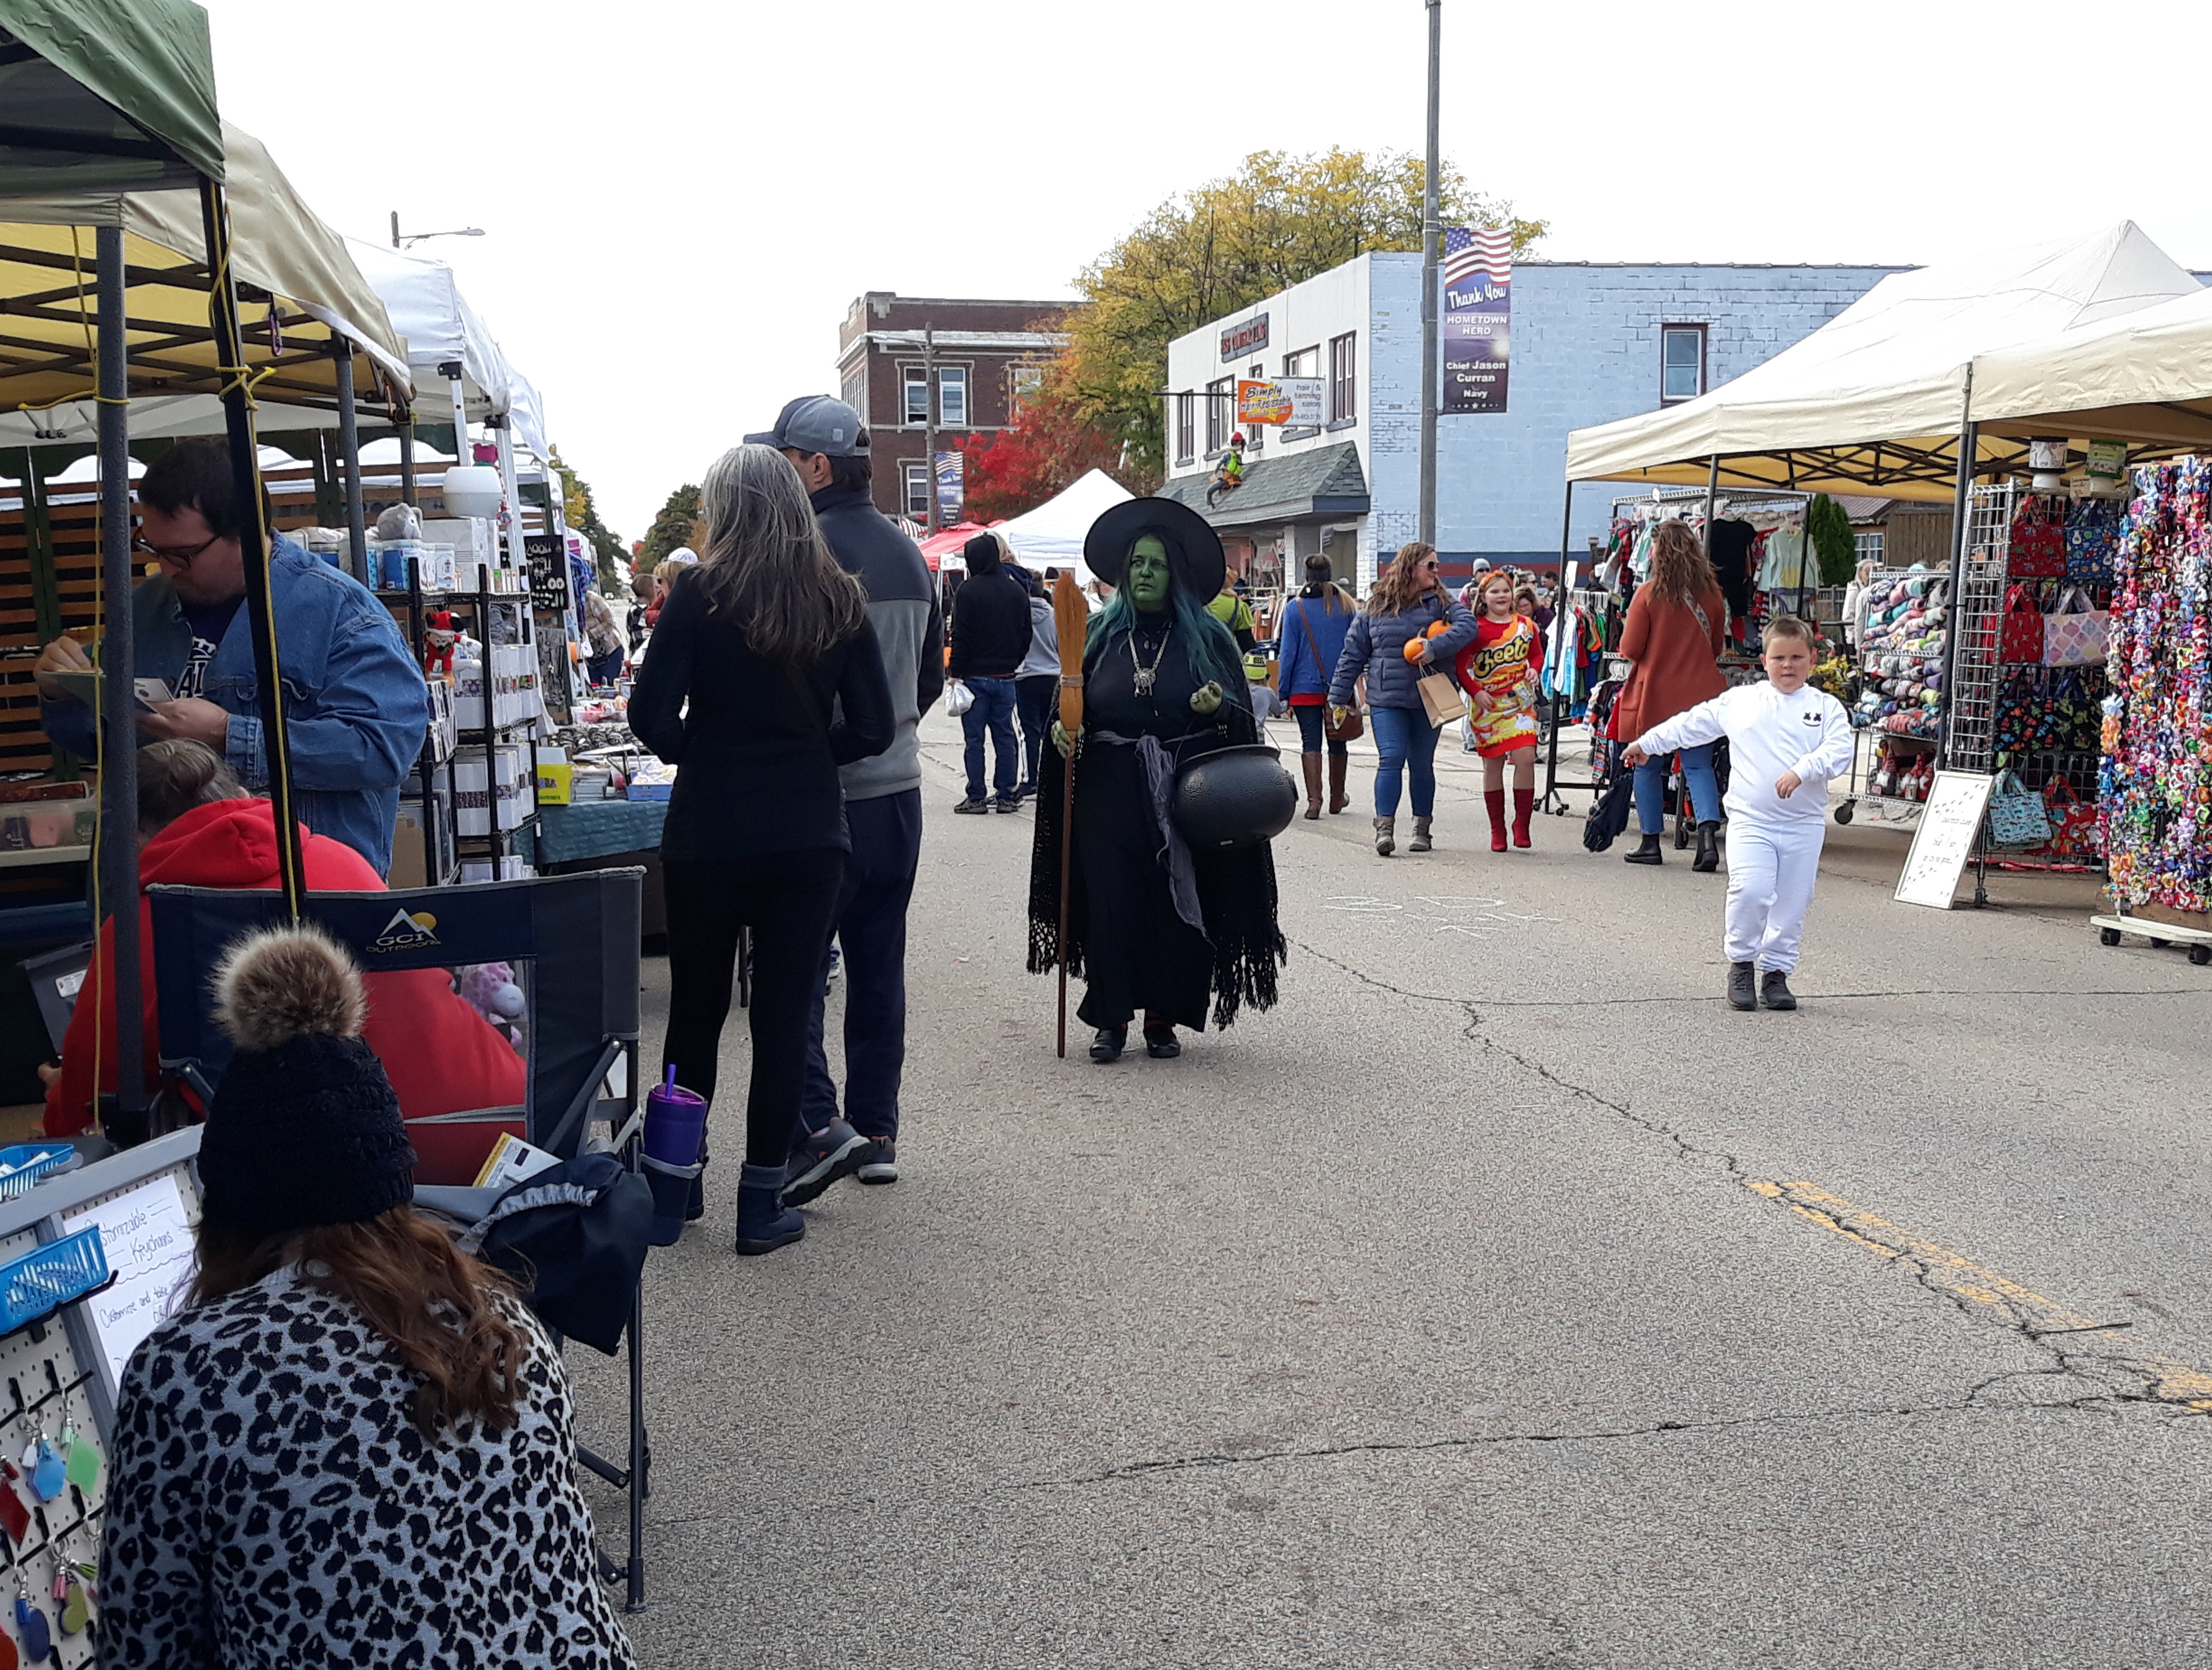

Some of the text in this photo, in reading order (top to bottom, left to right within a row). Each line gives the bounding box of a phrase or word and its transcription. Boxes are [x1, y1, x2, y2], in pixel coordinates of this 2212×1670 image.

[1447, 283, 1507, 309] Thank You
[1446, 316, 1508, 324] HOMETOWN
[1462, 327, 1492, 335] HERO
[1446, 360, 1506, 370] Chief Jason
[1456, 373, 1496, 383] Curran
[1246, 385, 1282, 398] Simply
[1463, 389, 1489, 399] Navy
[375, 933, 426, 947] GCI
